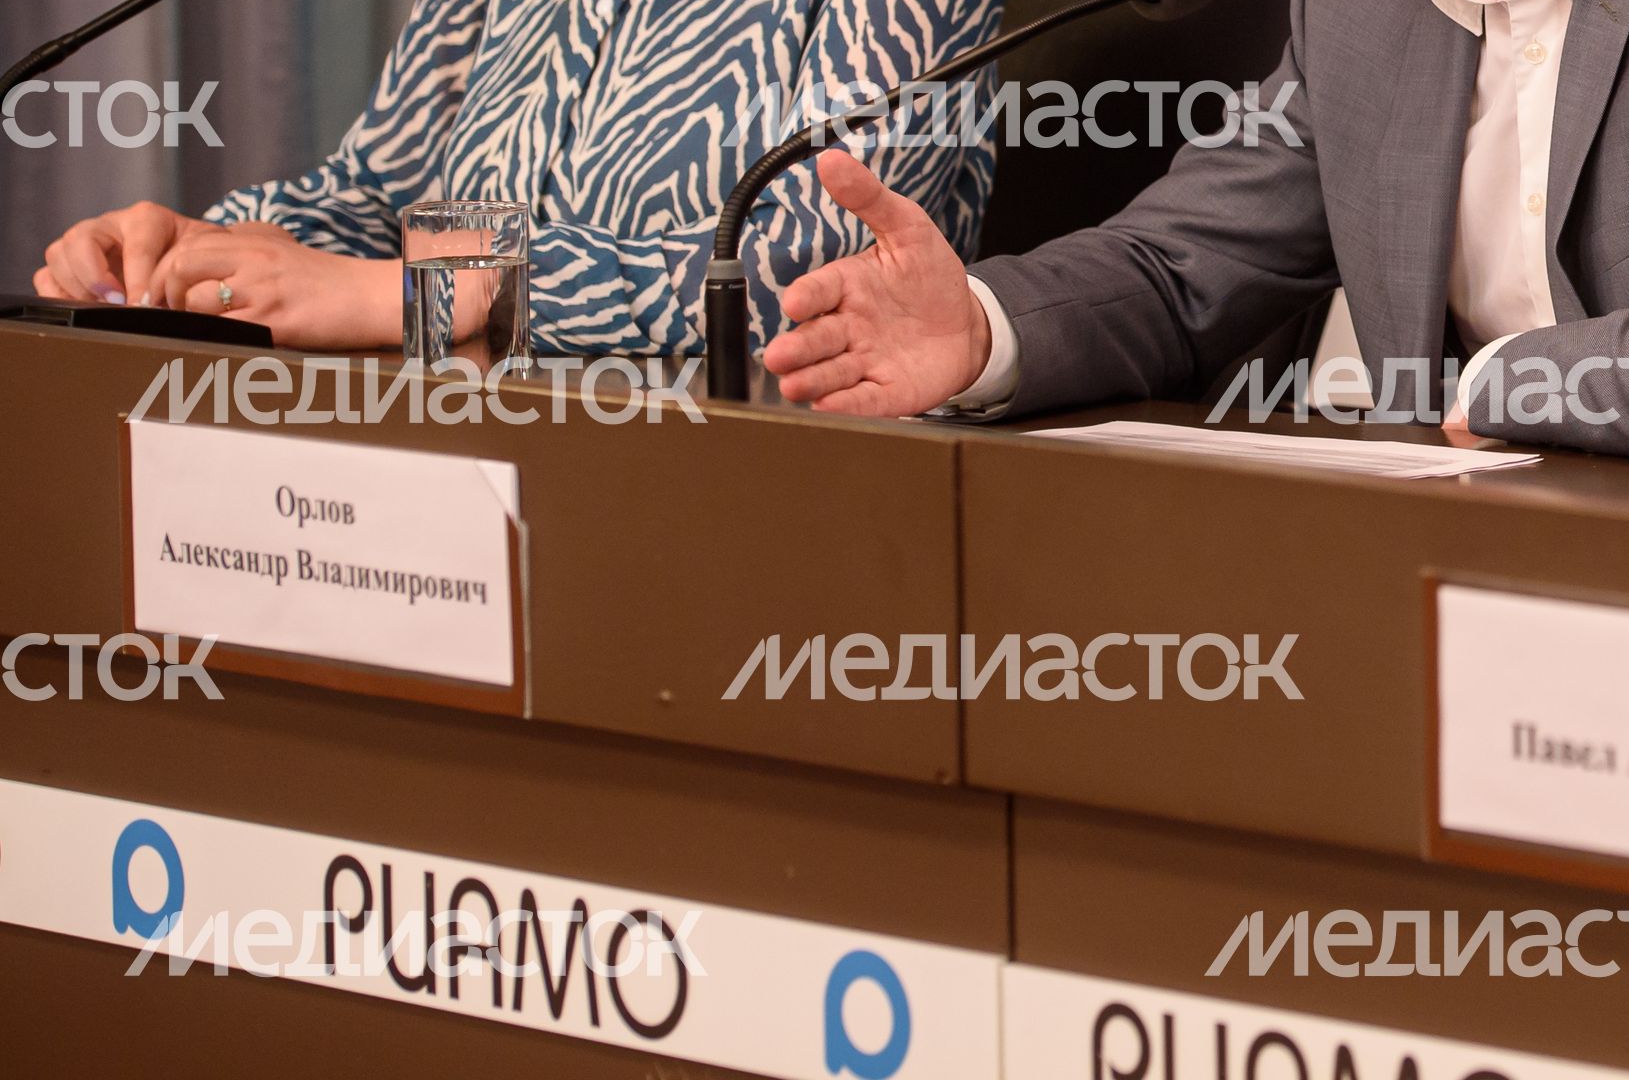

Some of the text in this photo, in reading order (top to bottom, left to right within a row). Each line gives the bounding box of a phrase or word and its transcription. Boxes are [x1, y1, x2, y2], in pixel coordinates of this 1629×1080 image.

[275, 485, 355, 528] Орлов
[160, 532, 488, 605] Александр Владимирович
[1511, 721, 1618, 774] Павел
